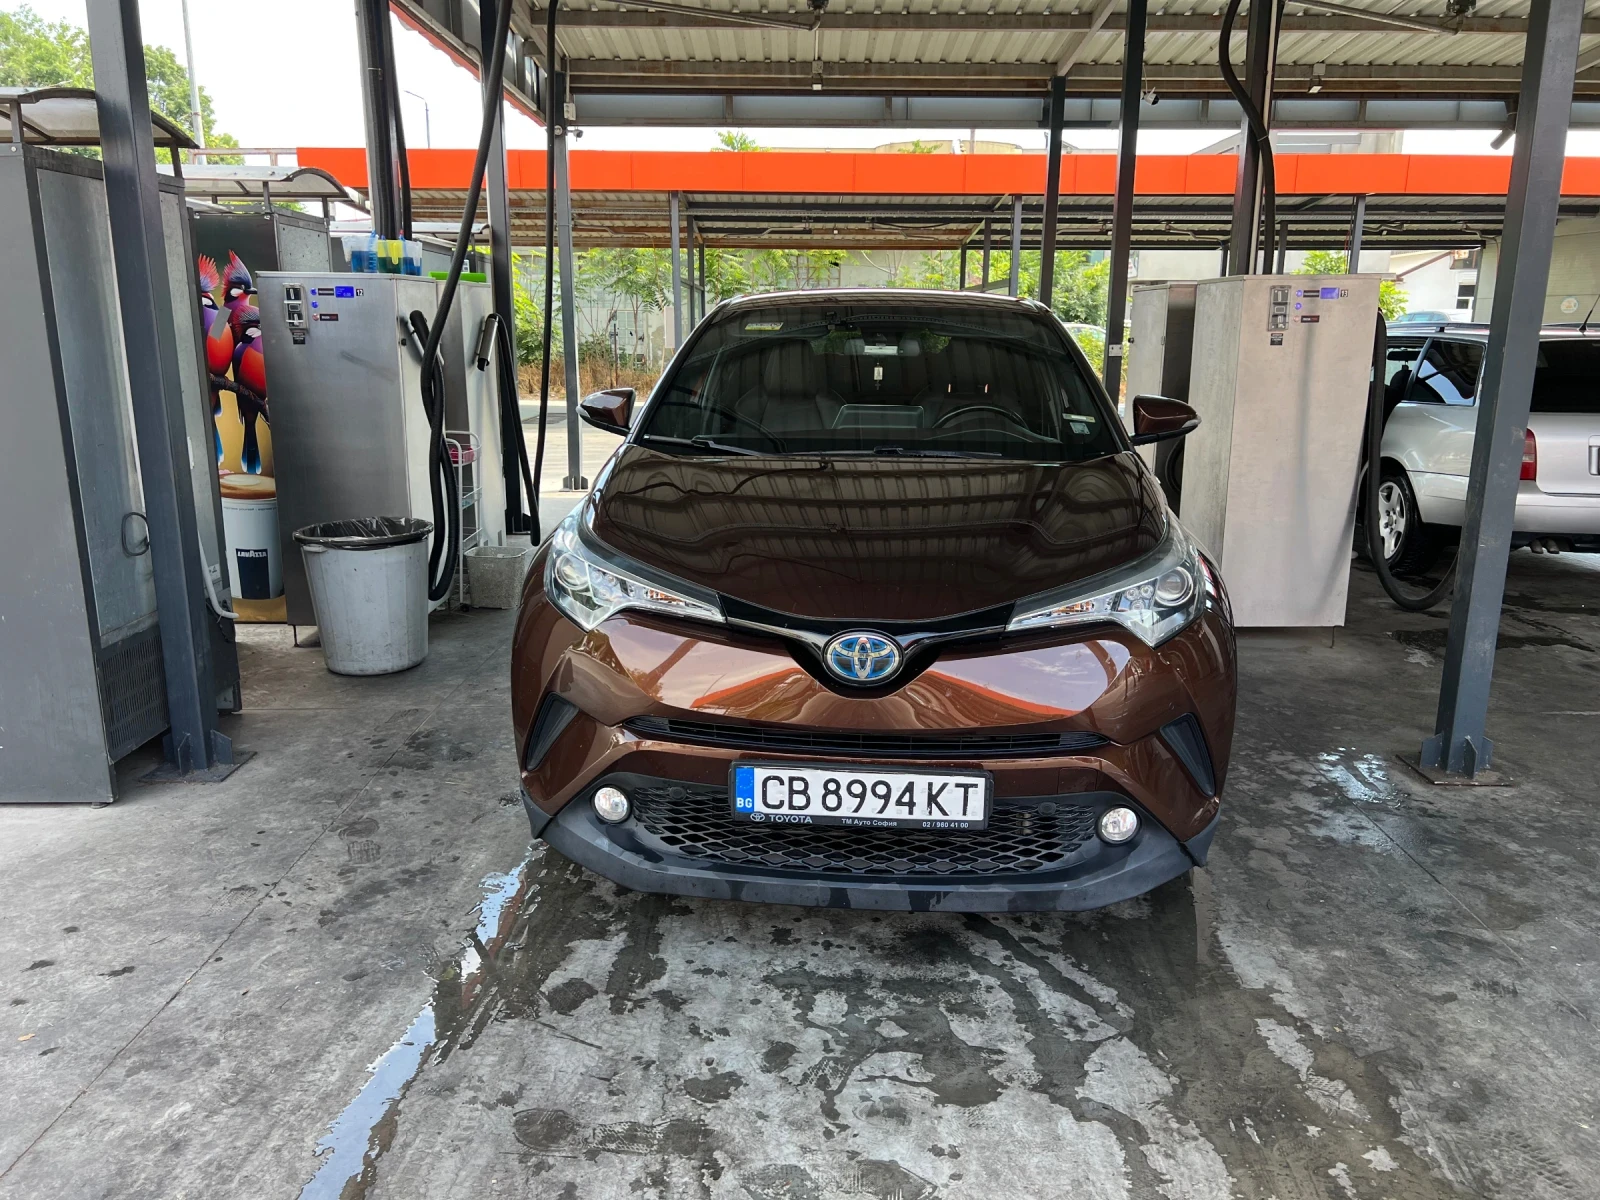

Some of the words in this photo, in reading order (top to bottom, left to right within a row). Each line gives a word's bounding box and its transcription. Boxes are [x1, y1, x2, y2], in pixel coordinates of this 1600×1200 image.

[237, 550, 267, 558] LAVAZZA
[761, 775, 811, 811] CB
[821, 778, 917, 815] 8994
[927, 781, 979, 817] KT
[736, 797, 752, 808] BG
[768, 814, 812, 824] TOYOTA
[853, 818, 871, 827] Ауто
[872, 819, 897, 828] София
